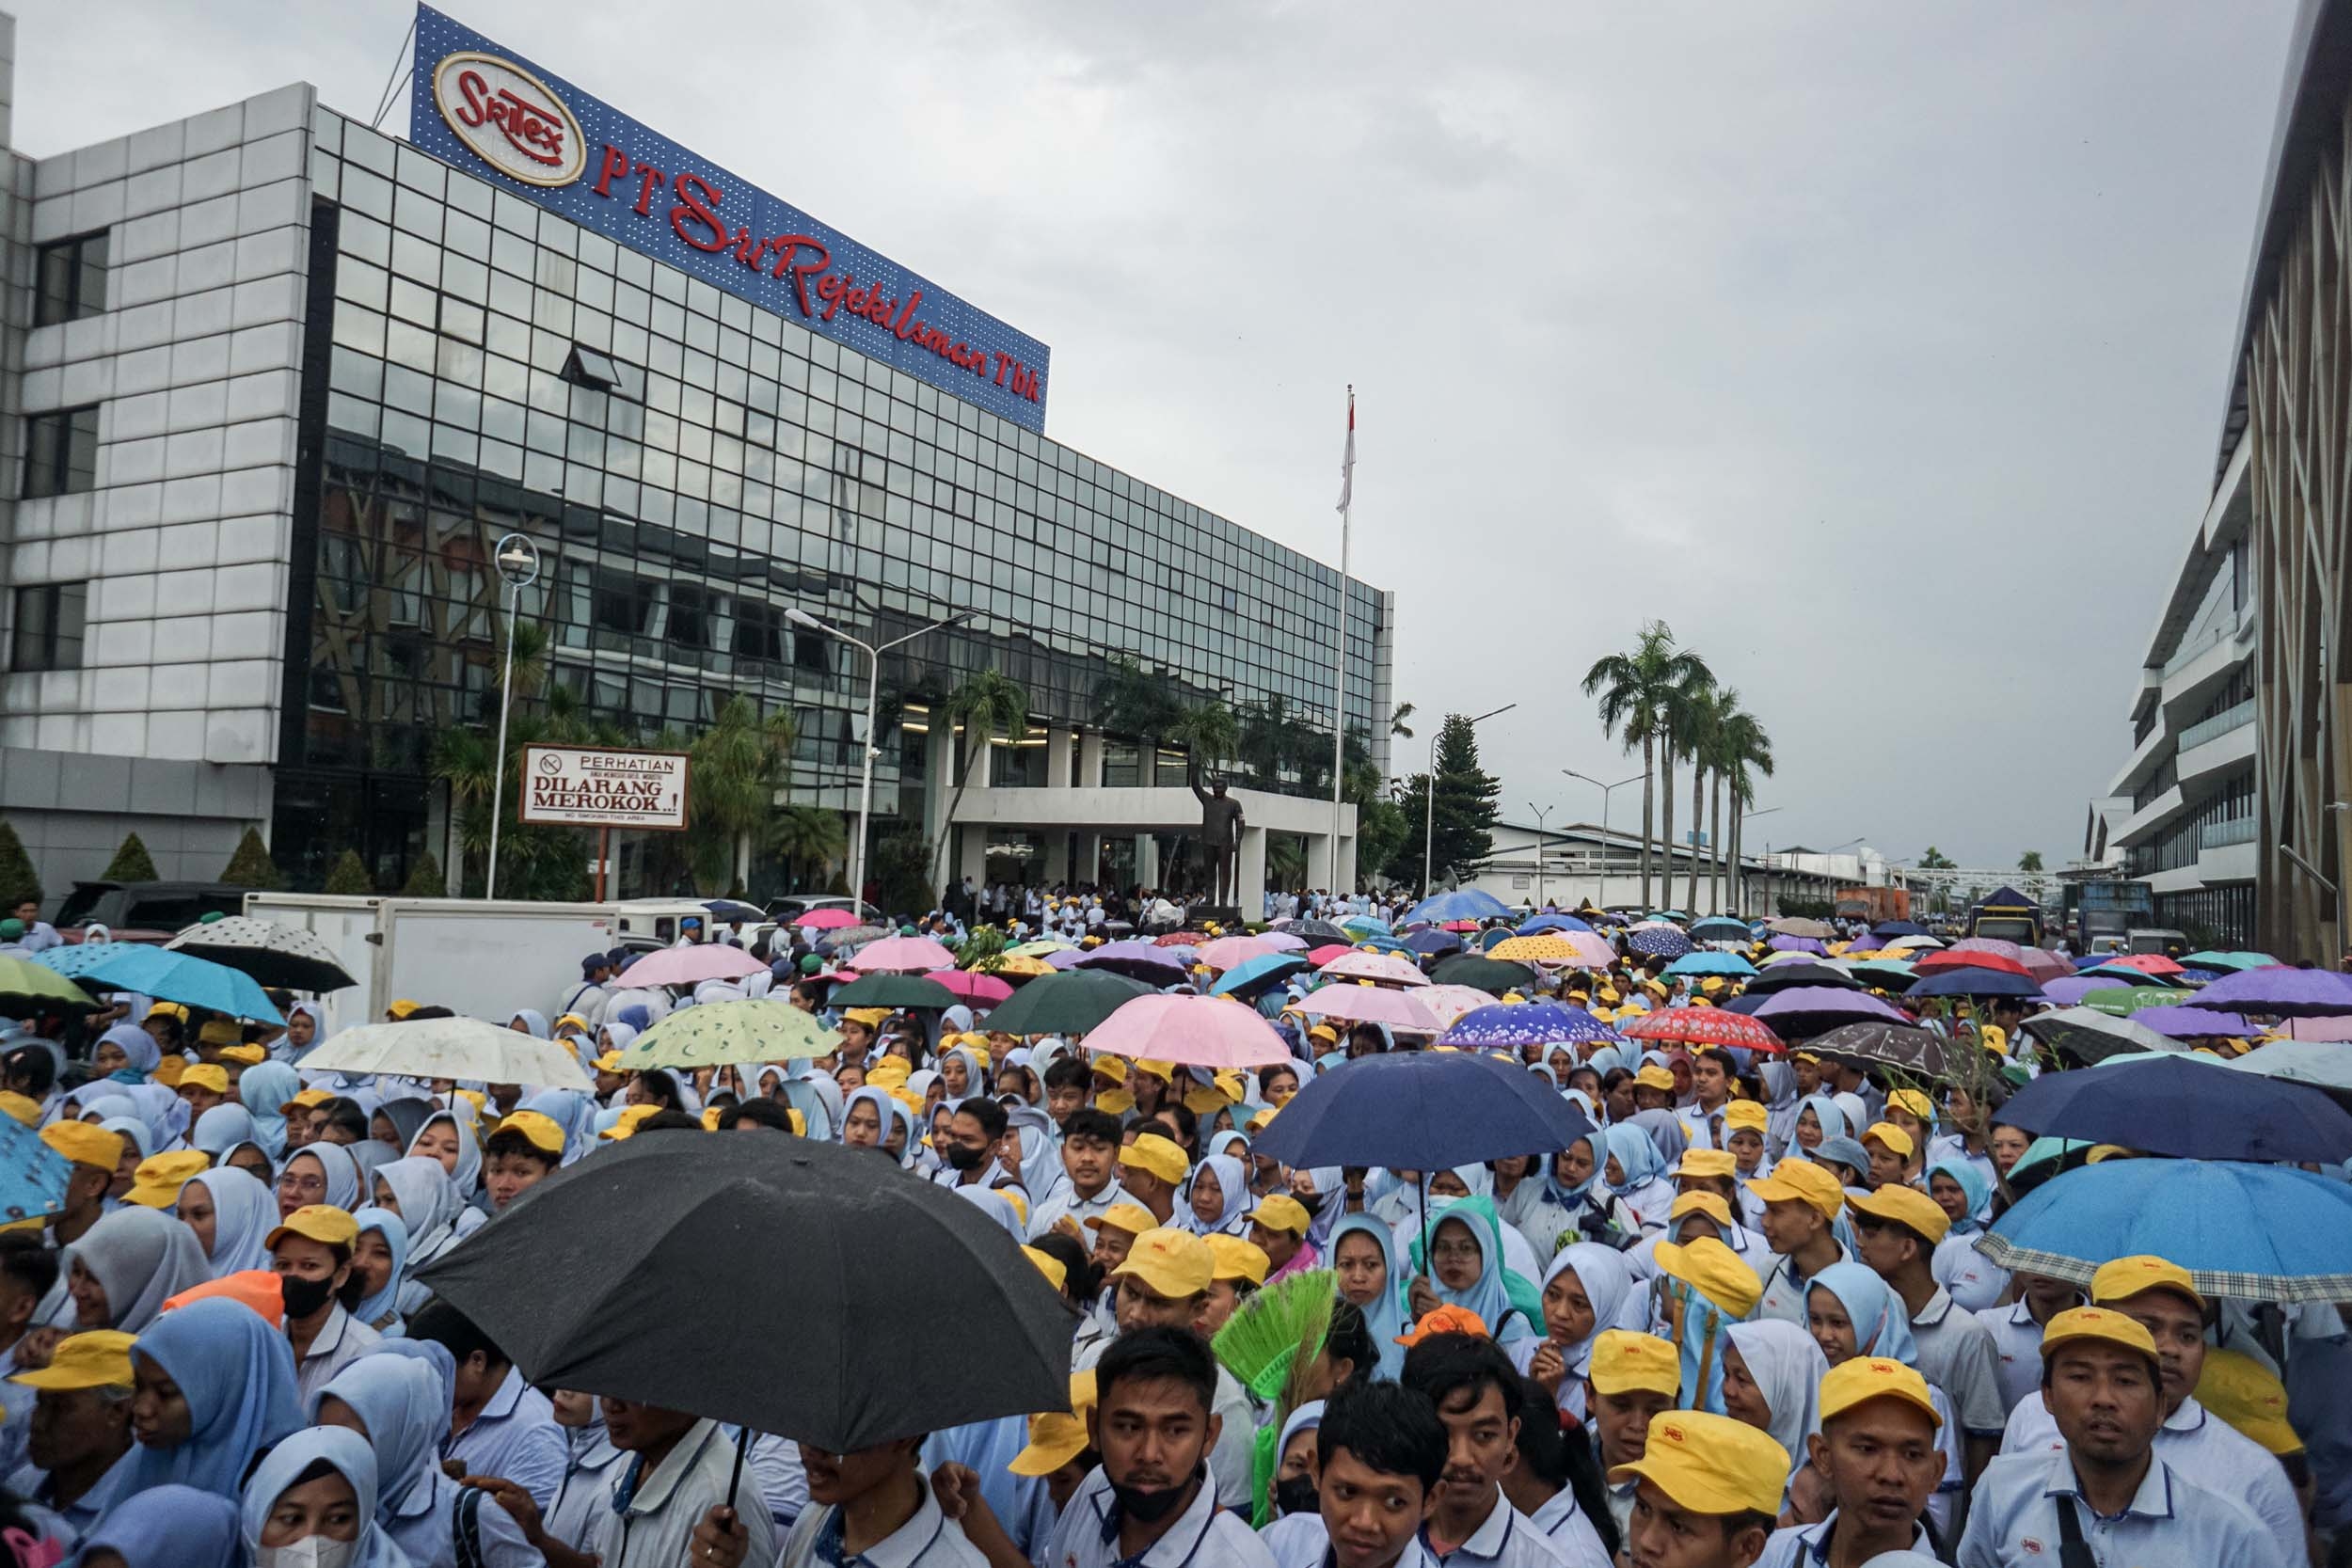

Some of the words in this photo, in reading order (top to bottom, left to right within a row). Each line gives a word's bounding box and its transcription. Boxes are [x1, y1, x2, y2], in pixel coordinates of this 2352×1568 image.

[593, 144, 666, 217] PT
[670, 173, 770, 272] Sri
[772, 234, 899, 322] Rejeki
[993, 351, 1042, 403] Tbk
[580, 755, 675, 771] PERHATIAN
[533, 776, 663, 797] DILARANG
